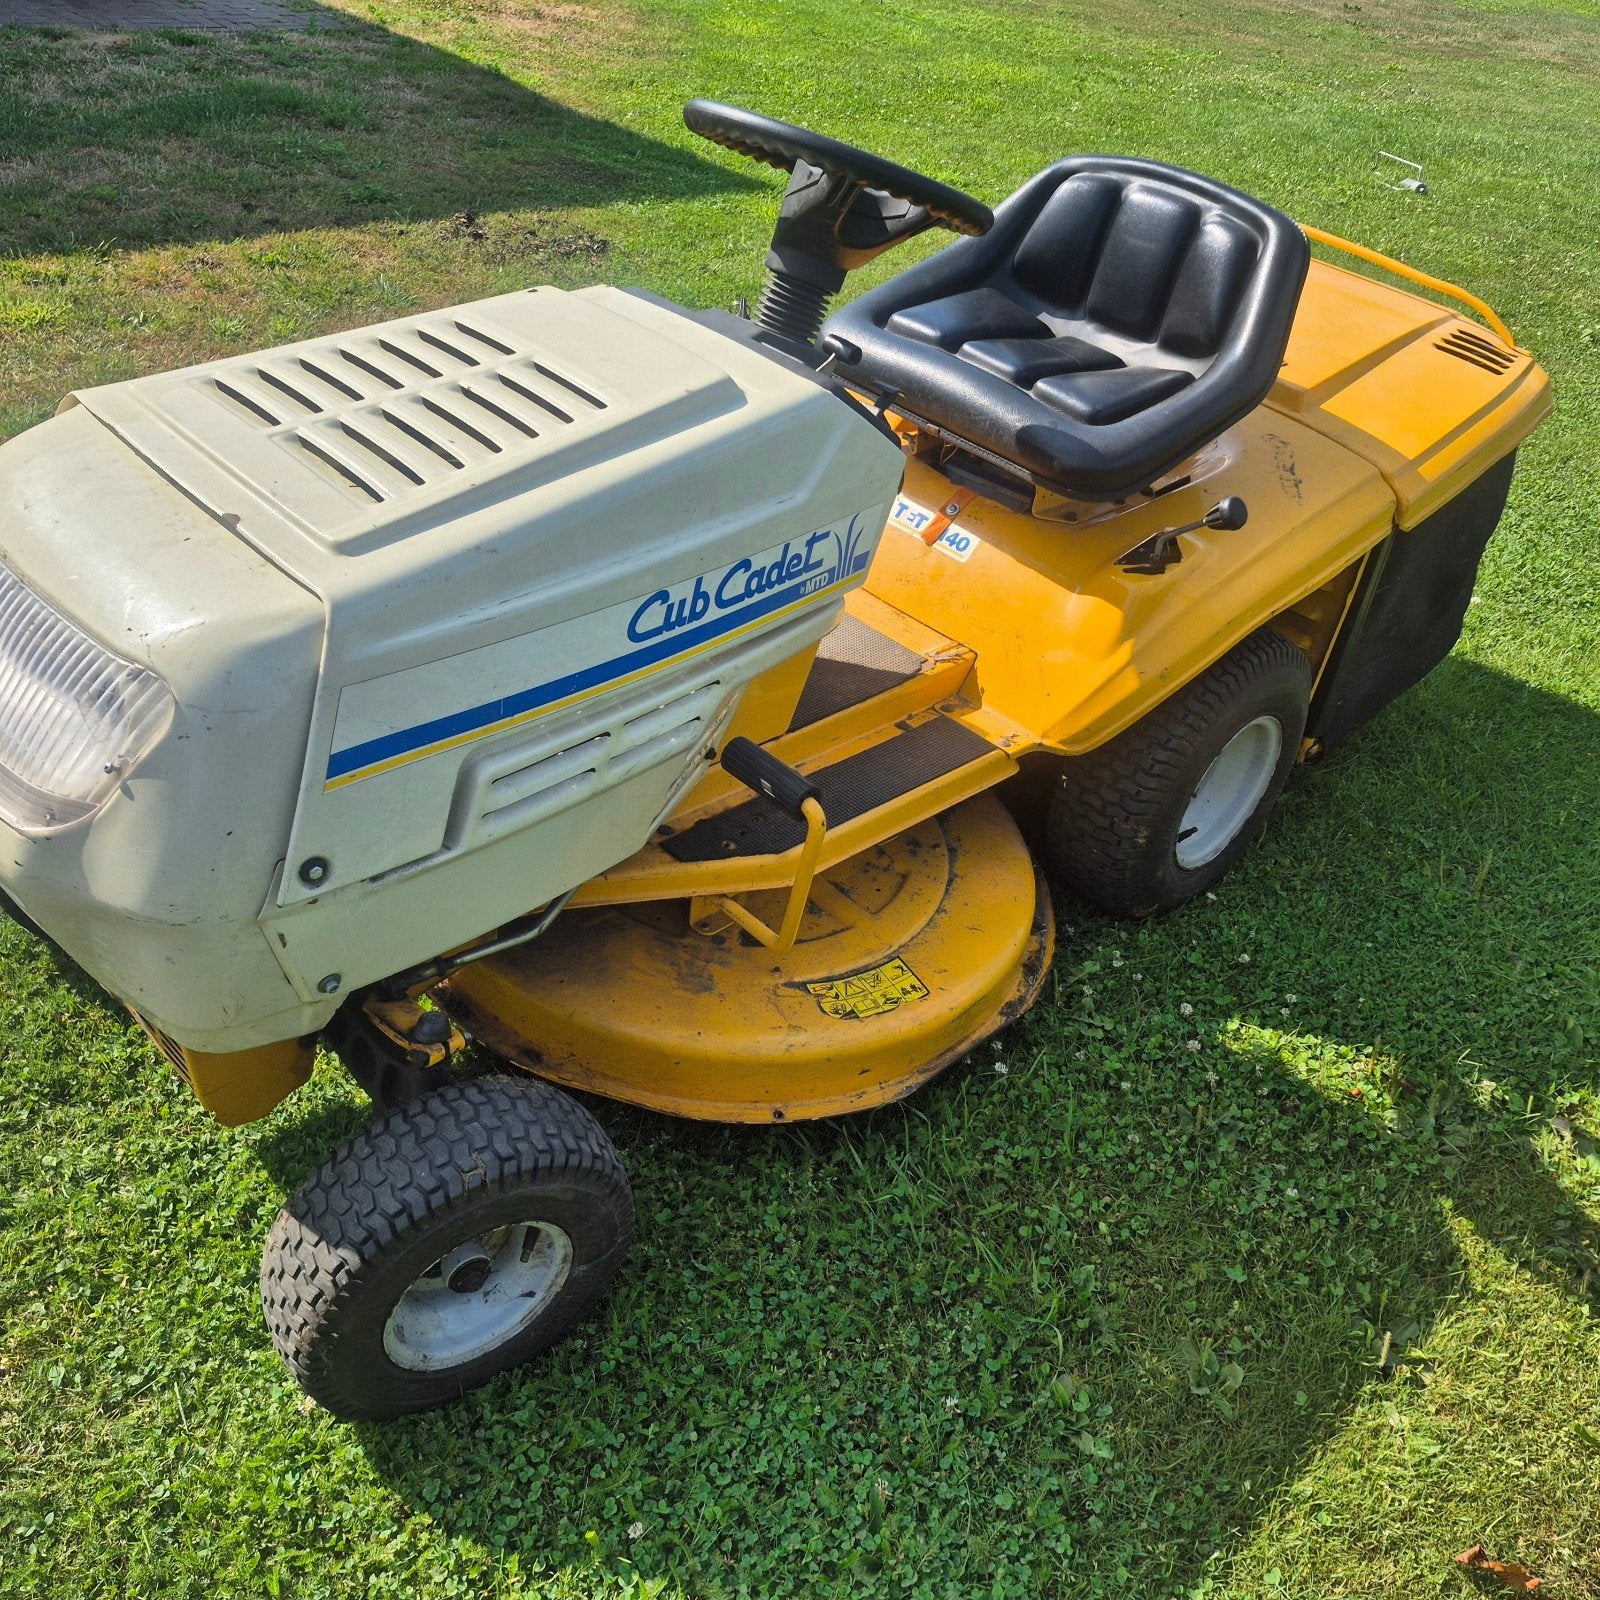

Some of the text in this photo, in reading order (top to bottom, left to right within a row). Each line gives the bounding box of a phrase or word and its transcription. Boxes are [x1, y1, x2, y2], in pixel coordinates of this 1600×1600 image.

[627, 531, 831, 643] Cub Cadet
[805, 572, 829, 593] MTD
